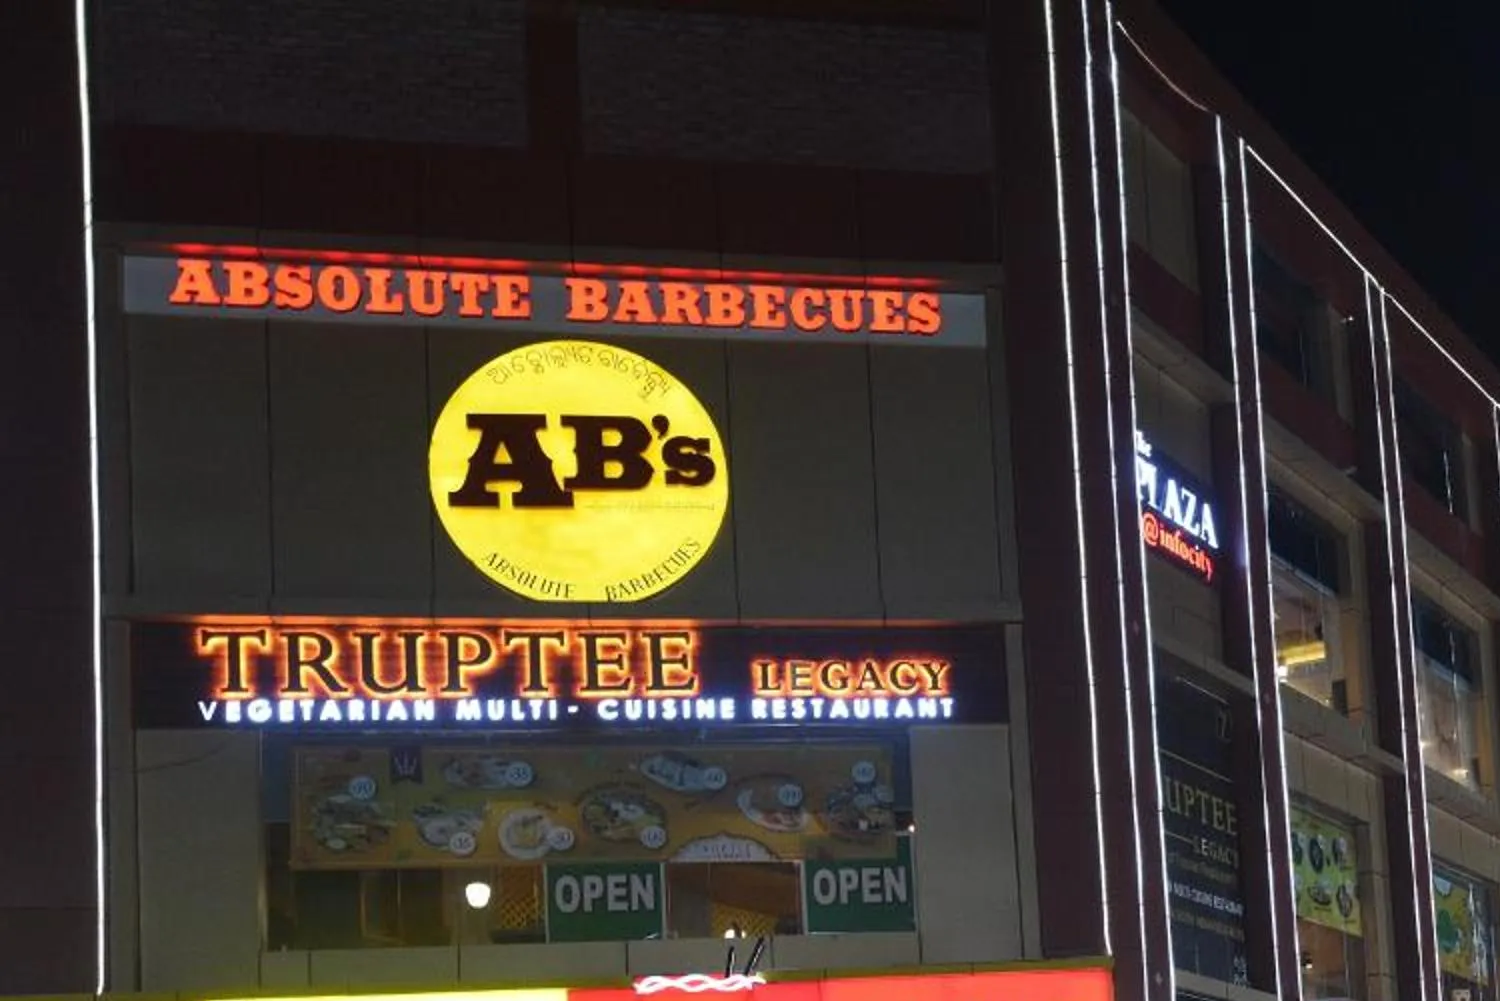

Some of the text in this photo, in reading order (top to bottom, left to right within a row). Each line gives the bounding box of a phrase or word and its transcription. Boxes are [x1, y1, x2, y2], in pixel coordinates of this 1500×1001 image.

[168, 257, 943, 336] ABSOLUTE BARBECUES
[448, 413, 716, 508] AB's
[1136, 456, 1219, 549] PLAZA
[481, 536, 702, 602] ABSOLUTE BARBECUES
[197, 624, 953, 700] TRUPTEE LEGACY
[198, 698, 435, 723] VEGETARIAN
[597, 698, 736, 721] CUISINE
[752, 697, 955, 719] RESTAURANT
[553, 871, 658, 914] OPEN
[811, 865, 908, 907] OPEN
